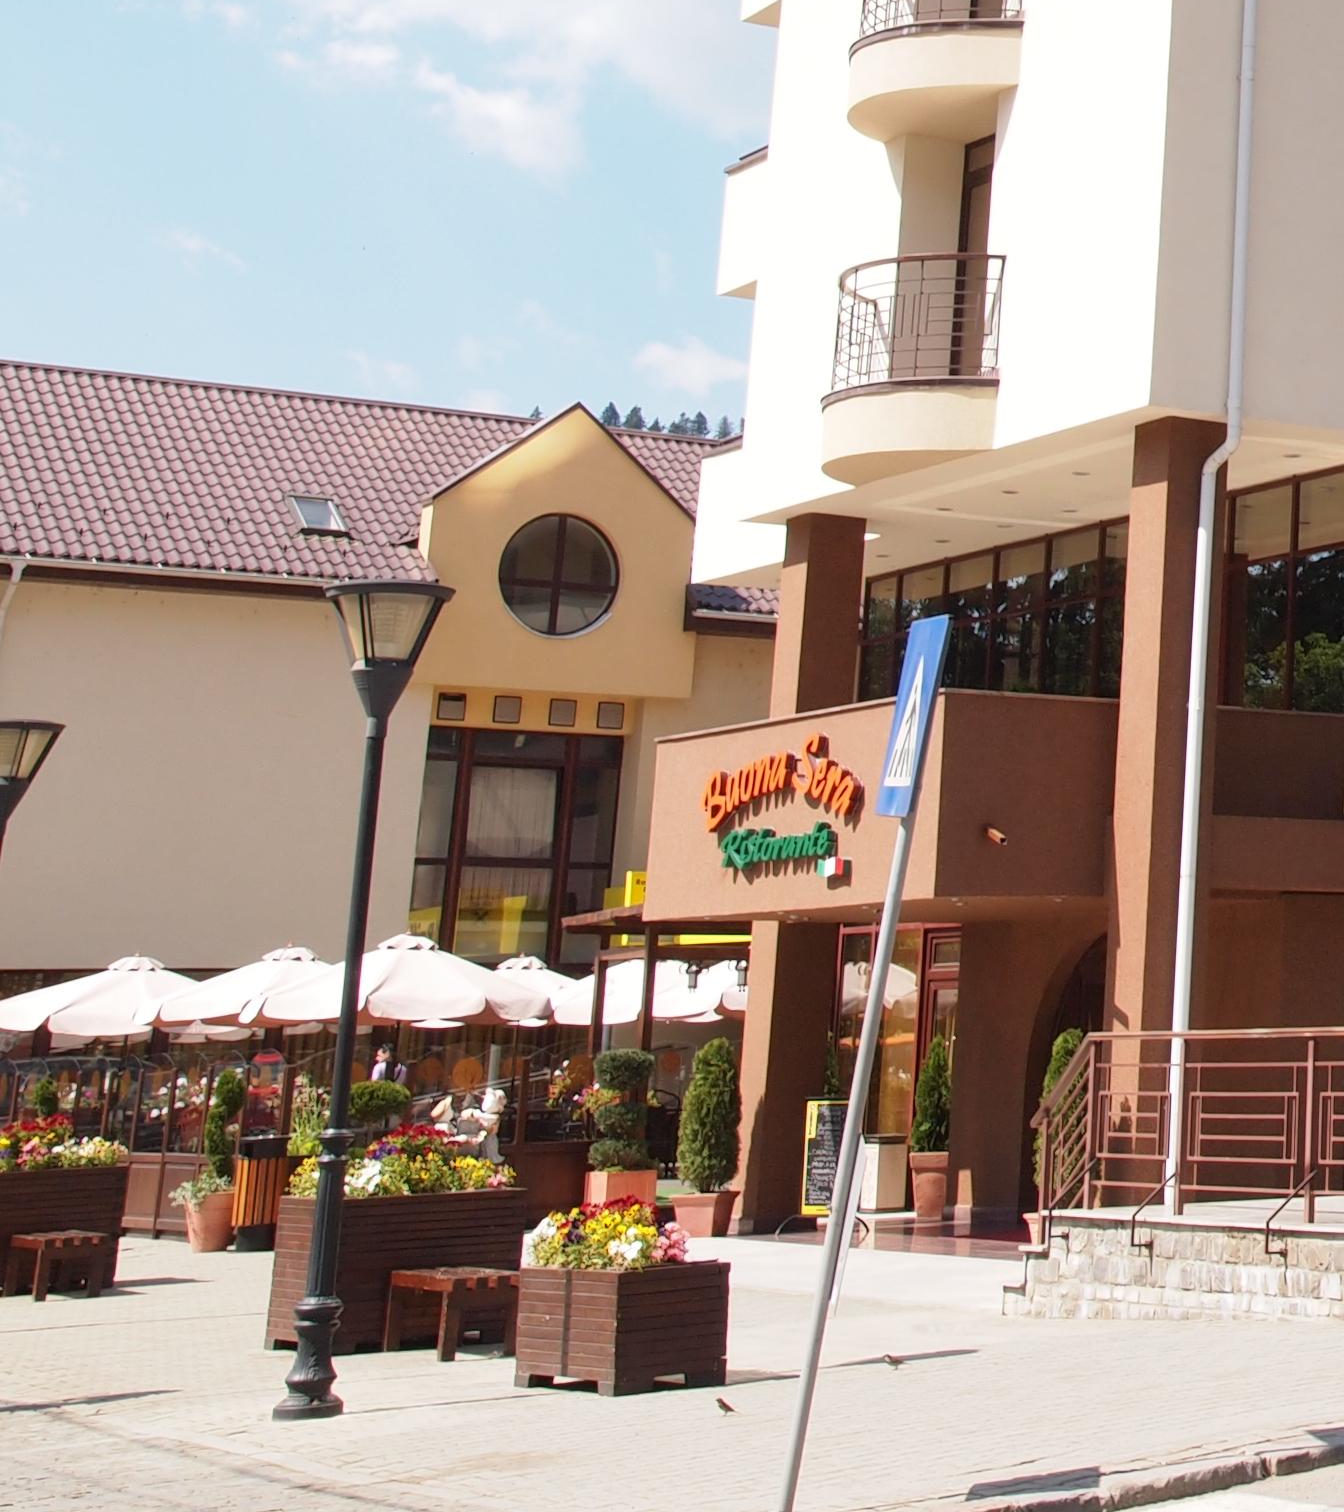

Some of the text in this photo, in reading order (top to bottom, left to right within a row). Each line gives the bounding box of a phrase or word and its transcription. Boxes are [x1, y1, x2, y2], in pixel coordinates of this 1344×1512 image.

[700, 731, 864, 833] Buona Sera
[720, 821, 838, 871] Ristorante
